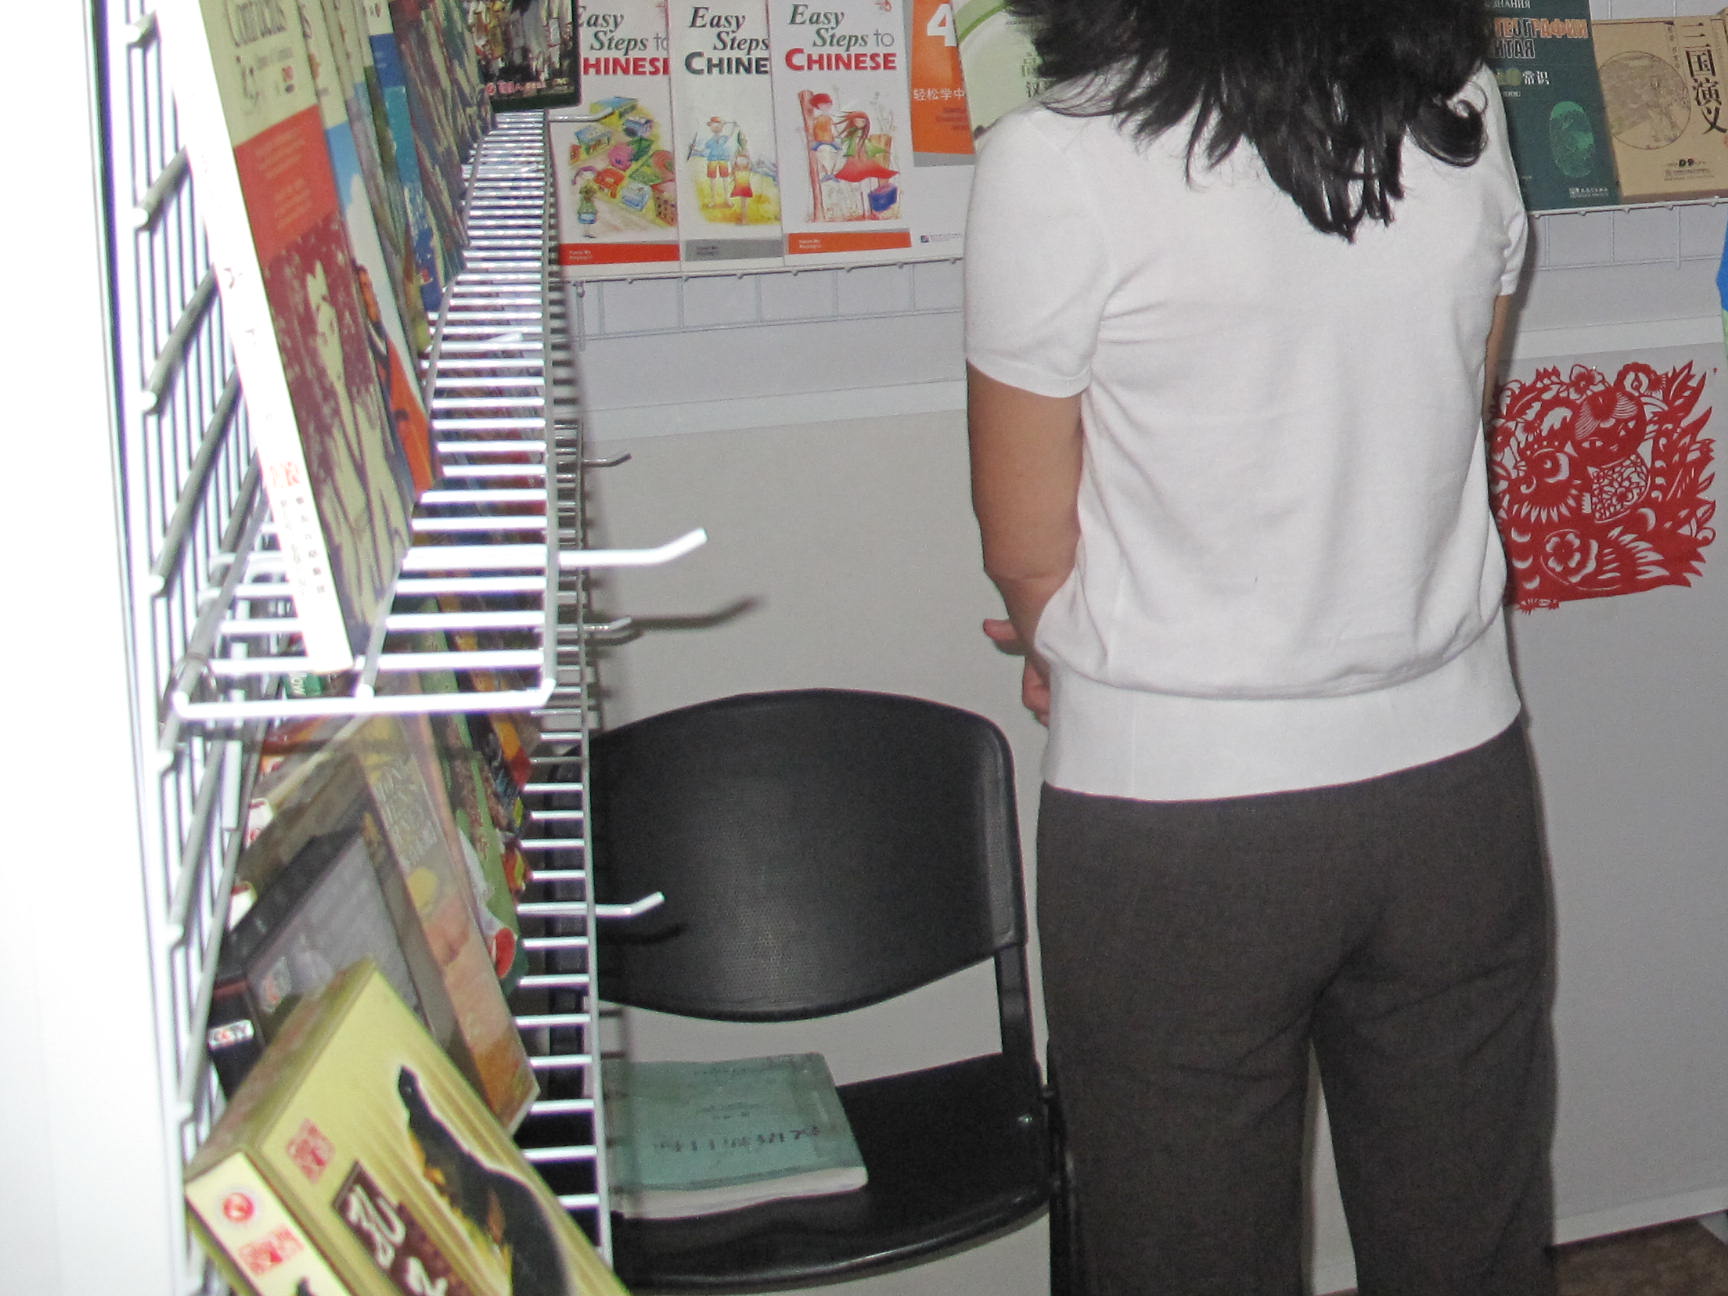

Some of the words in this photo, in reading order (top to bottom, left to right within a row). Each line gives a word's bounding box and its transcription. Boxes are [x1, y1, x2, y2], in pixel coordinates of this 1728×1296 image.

[689, 6, 747, 32] Easy
[789, 4, 846, 29] Easy
[926, 3, 958, 47] 4
[590, 30, 648, 56] Steps
[713, 30, 769, 56] Steps
[813, 27, 869, 52] Steps
[874, 28, 896, 48] to
[685, 51, 769, 76] CHINE
[784, 48, 897, 72] CHINESE
[1680, 21, 1728, 136] 三国演义
